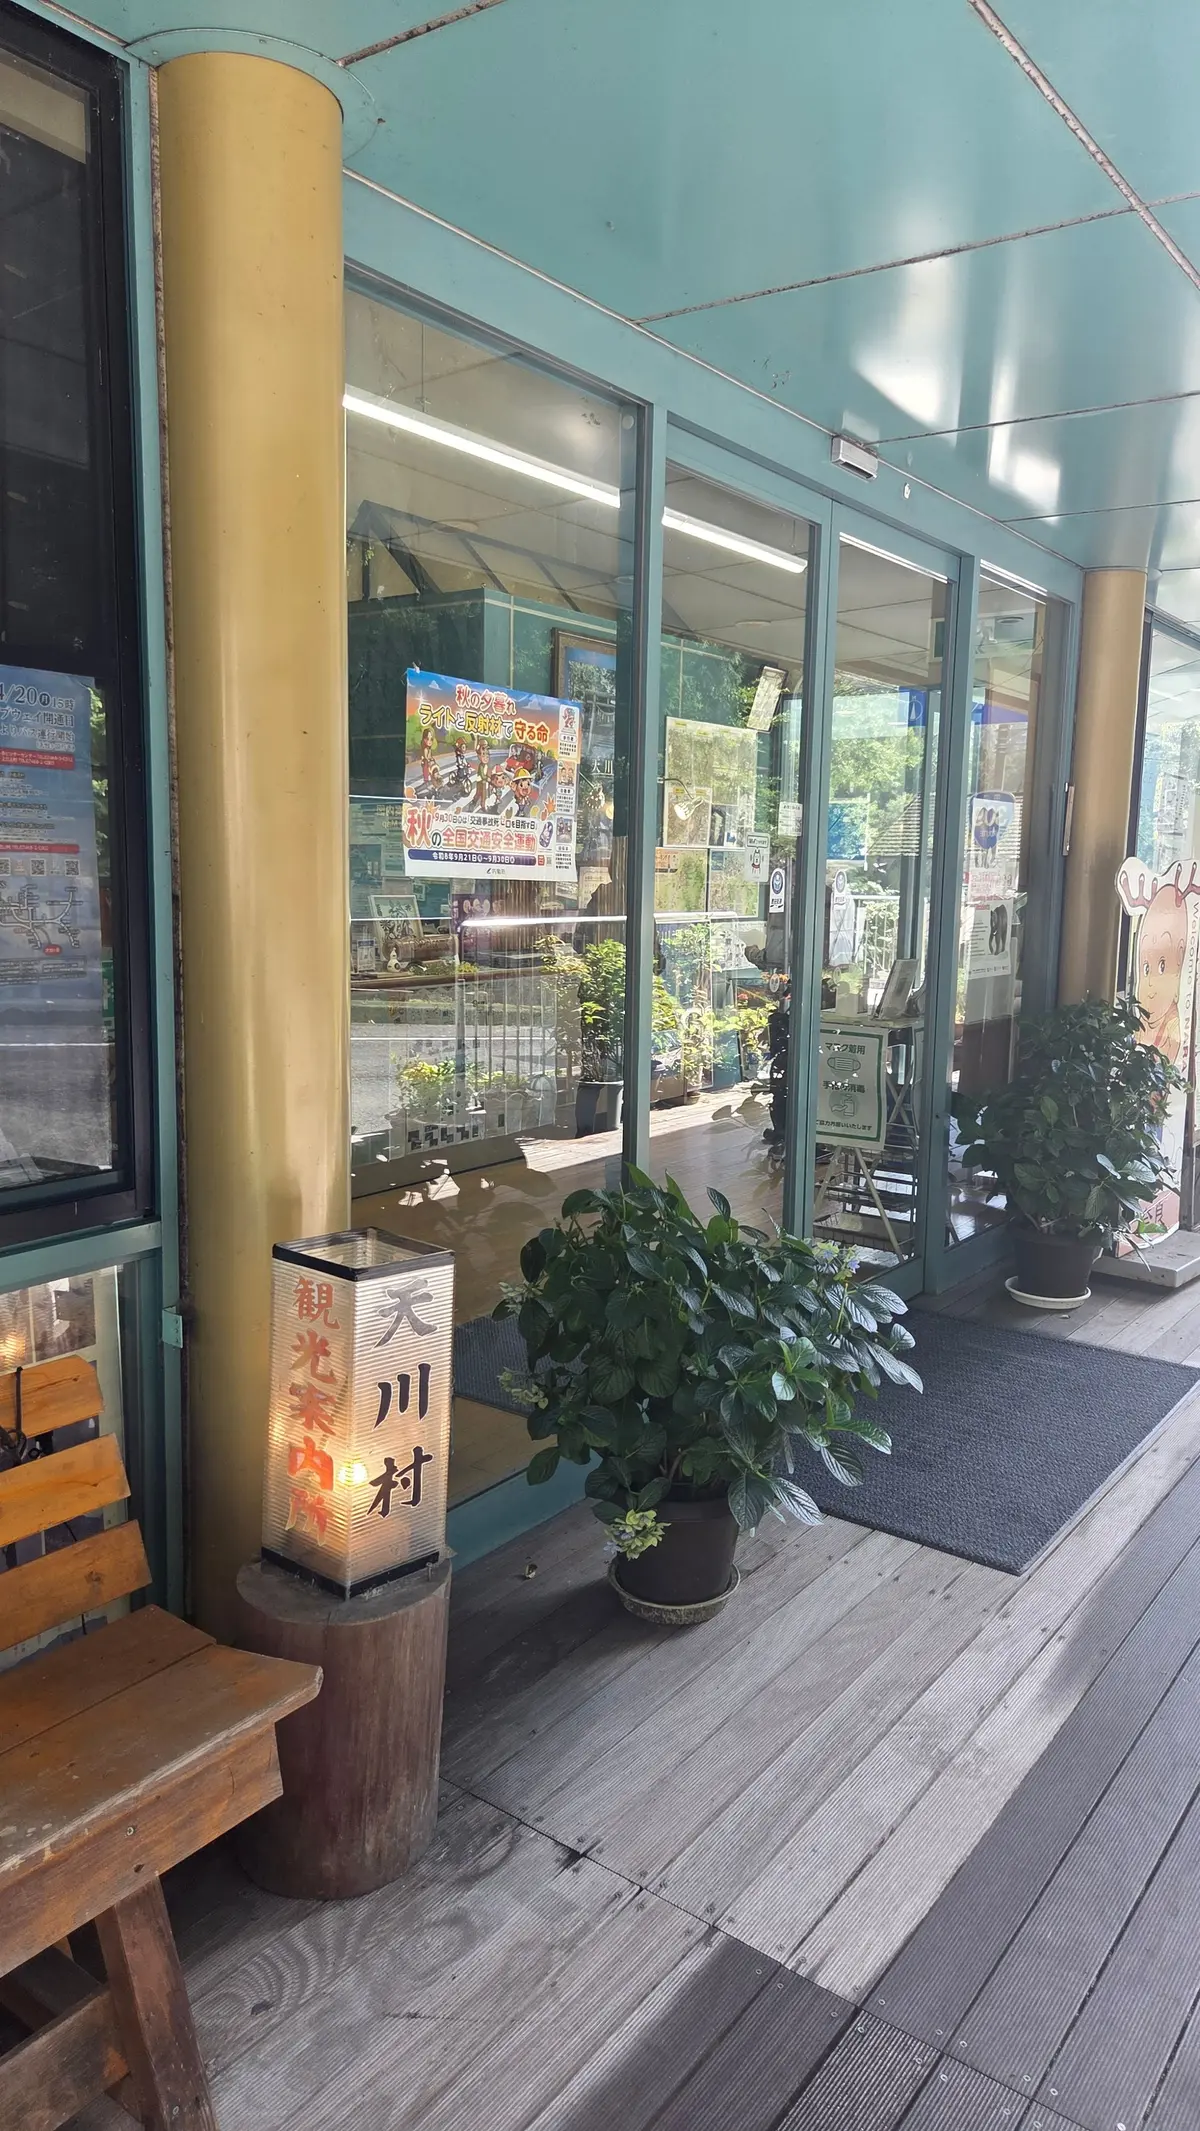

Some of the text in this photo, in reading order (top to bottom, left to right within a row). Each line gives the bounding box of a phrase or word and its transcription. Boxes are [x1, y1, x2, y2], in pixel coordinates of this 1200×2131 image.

[456, 684, 516, 715] 秋の夕暮れ
[418, 704, 549, 744] ライトと反射材で守る命
[406, 808, 537, 853] 秋の全国交通安全運動
[284, 1277, 341, 1547] 観光案内所
[366, 1276, 440, 1520] 天川村
